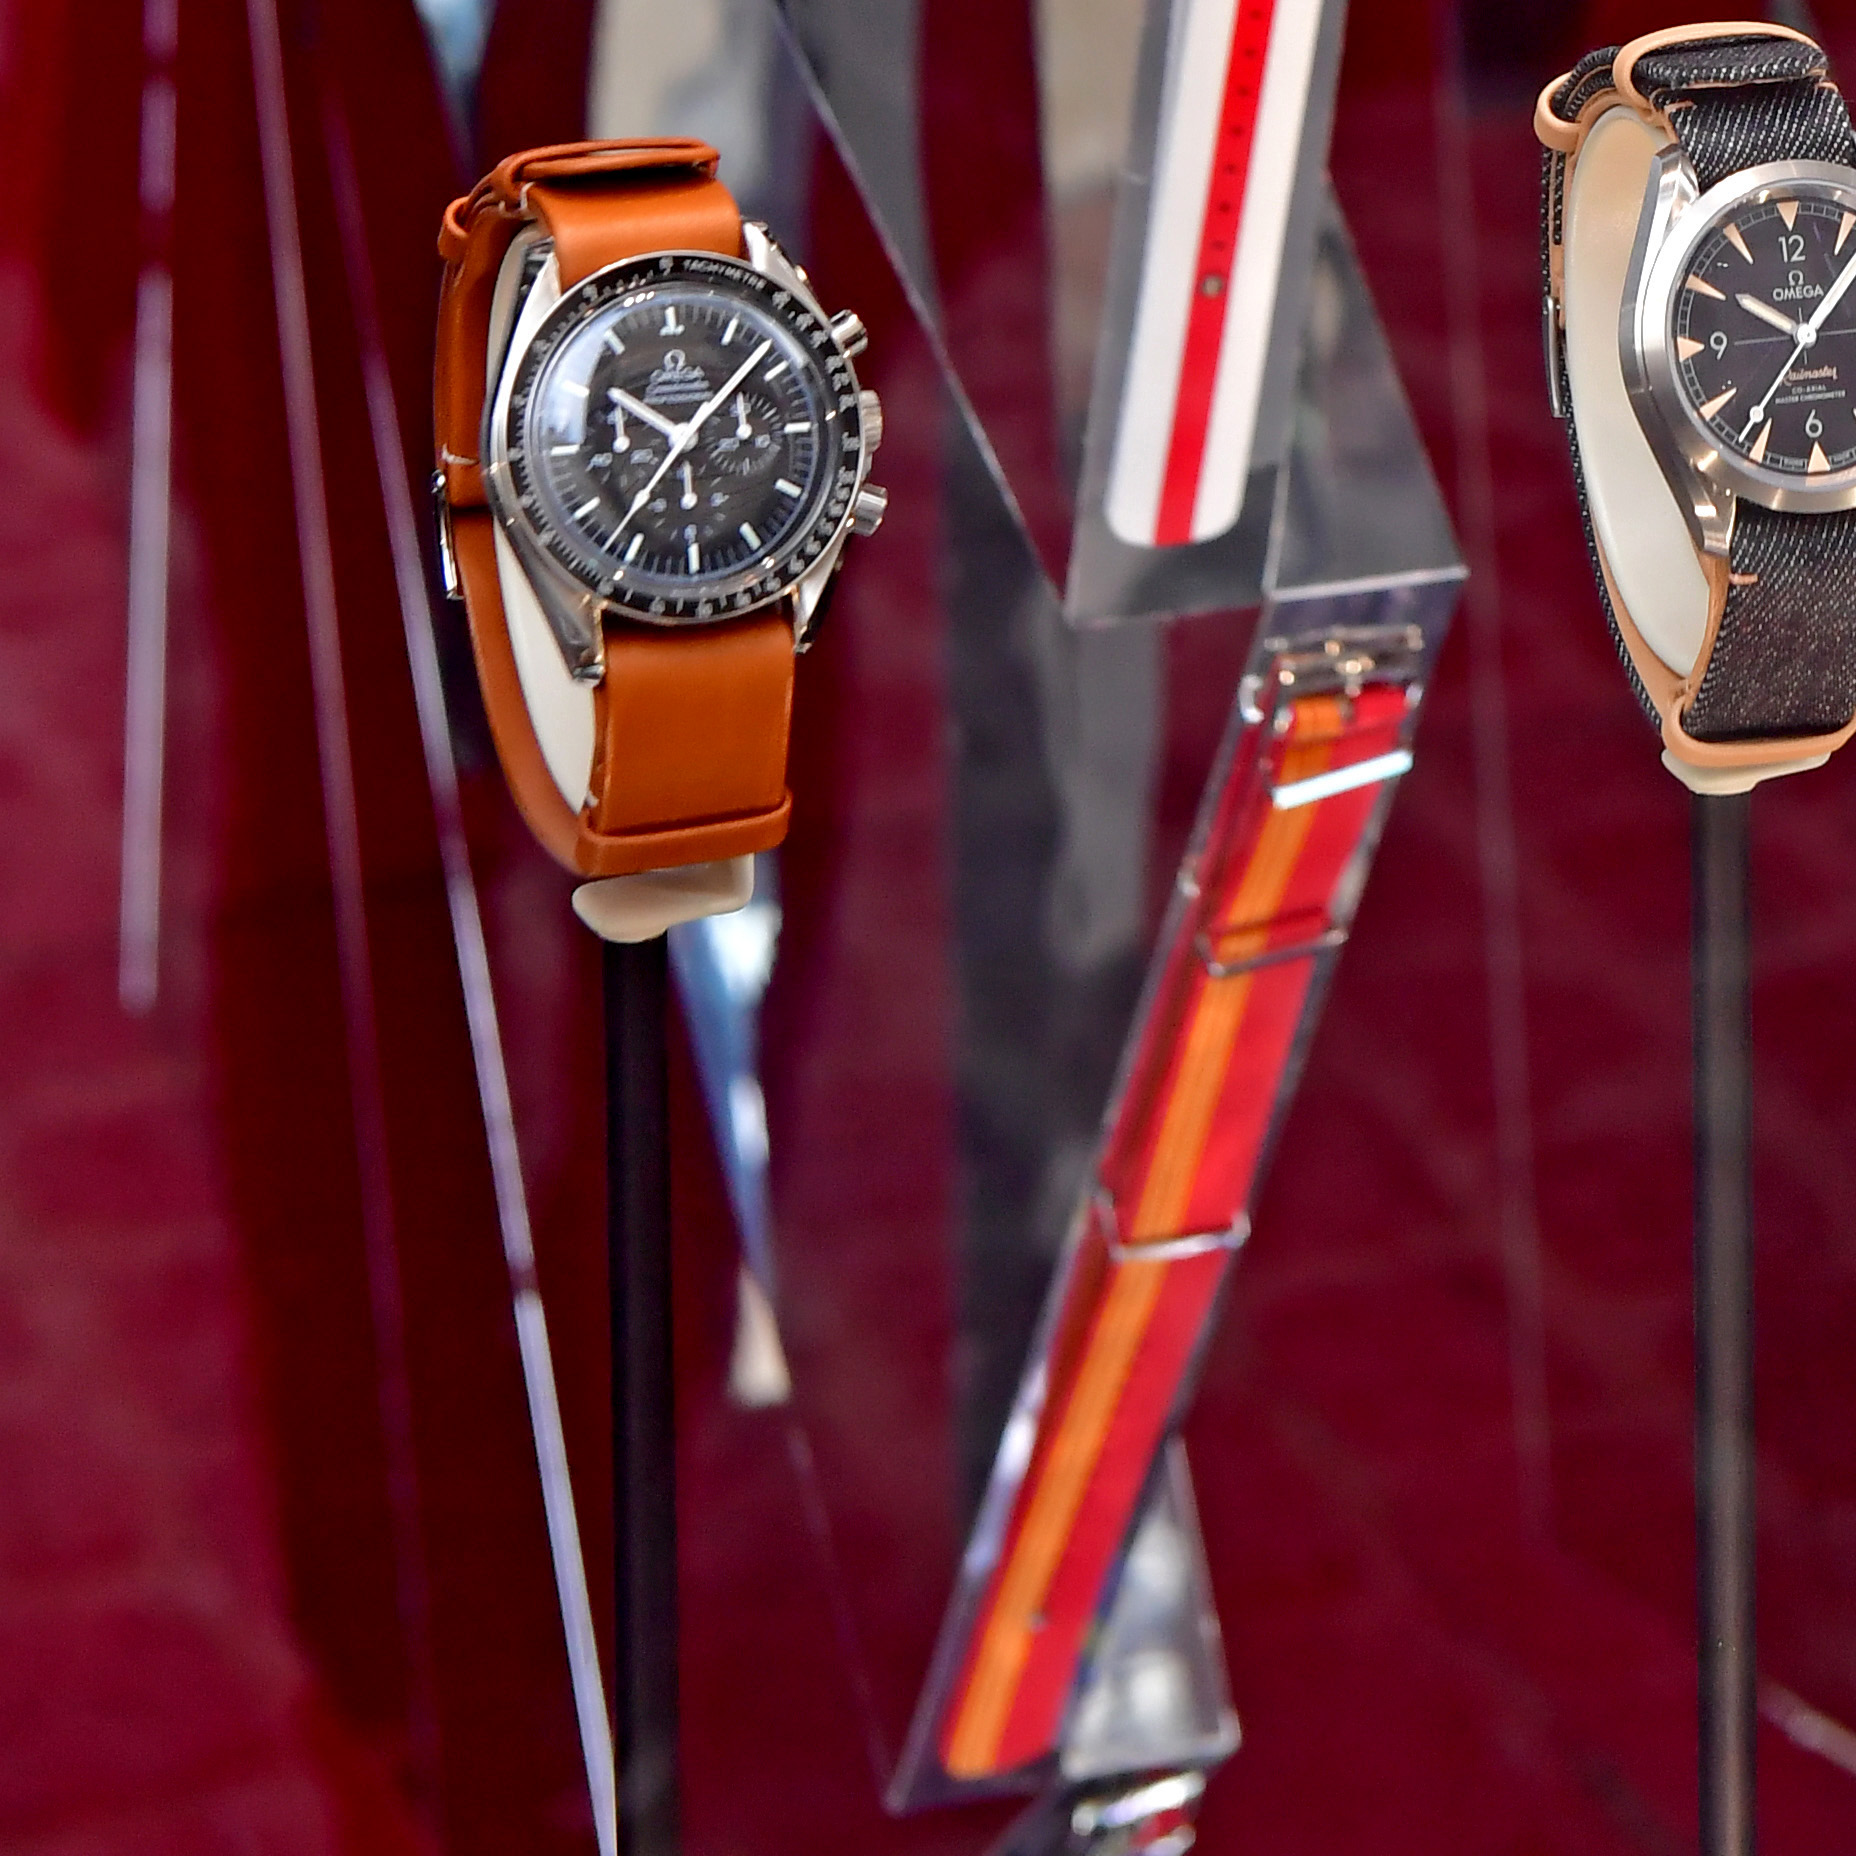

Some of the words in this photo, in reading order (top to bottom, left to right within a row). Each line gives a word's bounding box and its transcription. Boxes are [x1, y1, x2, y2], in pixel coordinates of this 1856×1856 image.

[1778, 234, 1806, 264] 12
[1773, 283, 1825, 302] OMEGA
[1710, 331, 1728, 360] 9
[1805, 408, 1823, 438] 6
